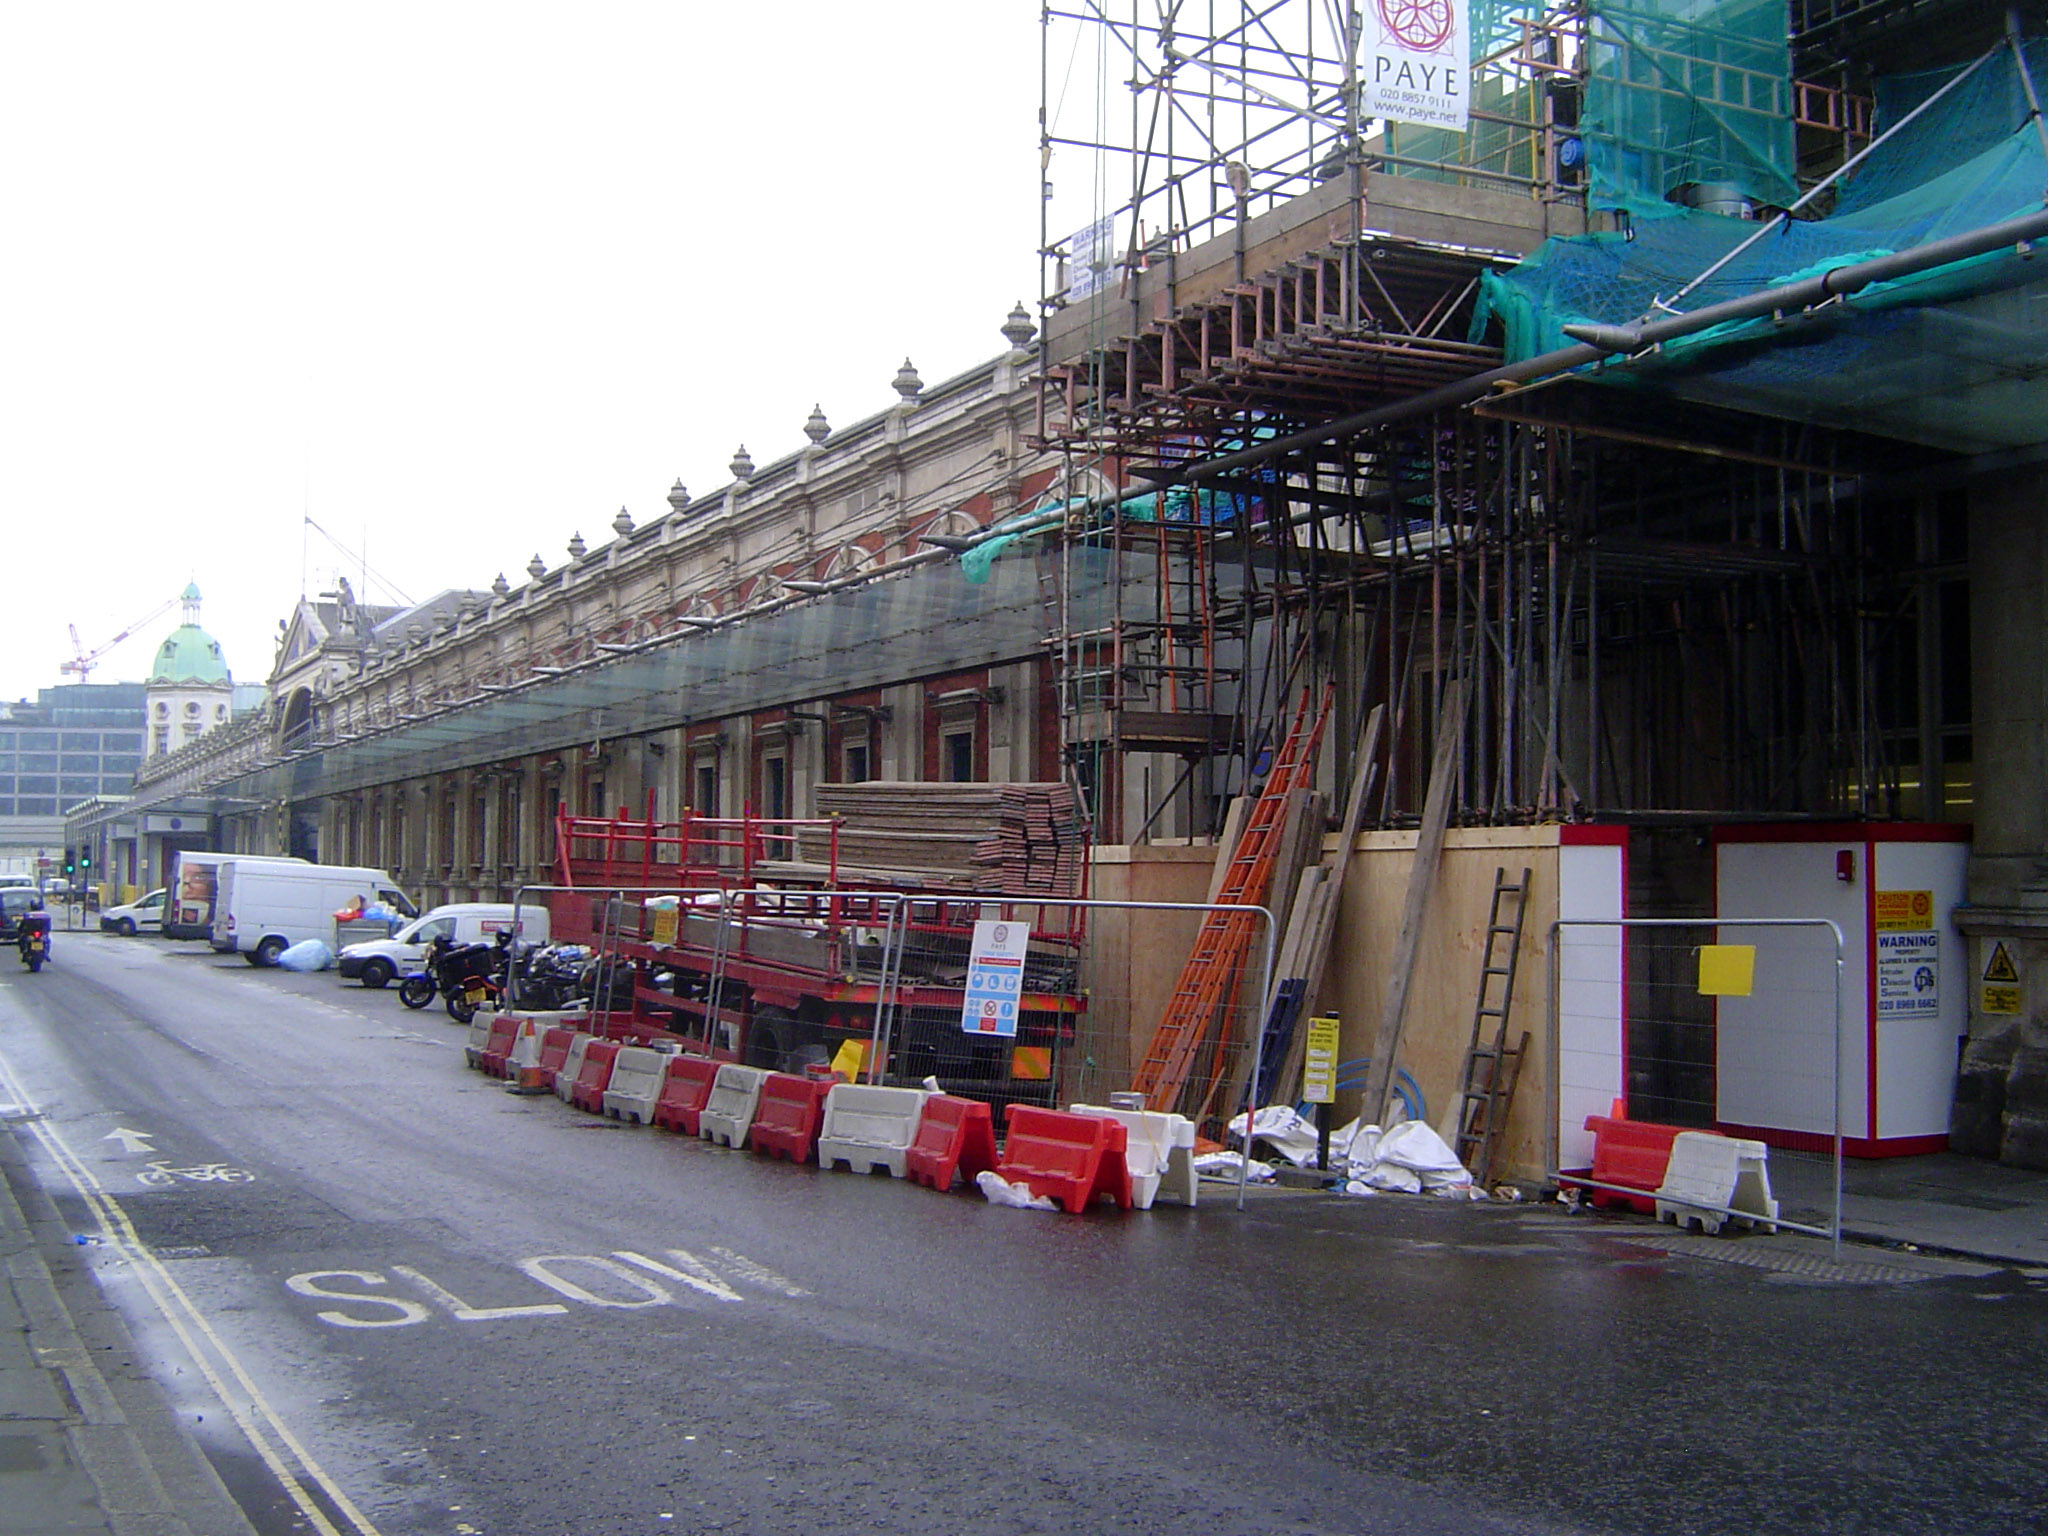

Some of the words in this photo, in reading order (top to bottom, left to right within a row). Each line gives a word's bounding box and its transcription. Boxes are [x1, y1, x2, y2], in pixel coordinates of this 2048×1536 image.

[1375, 54, 1459, 97] PAYE
[1380, 88, 1400, 100] 020
[1428, 96, 1452, 109] 9111
[1374, 101, 1458, 123] www.paye.net
[1879, 935, 1937, 948] WARNING
[1879, 1000, 1894, 1010] 020
[286, 1246, 806, 1328] SLOW
